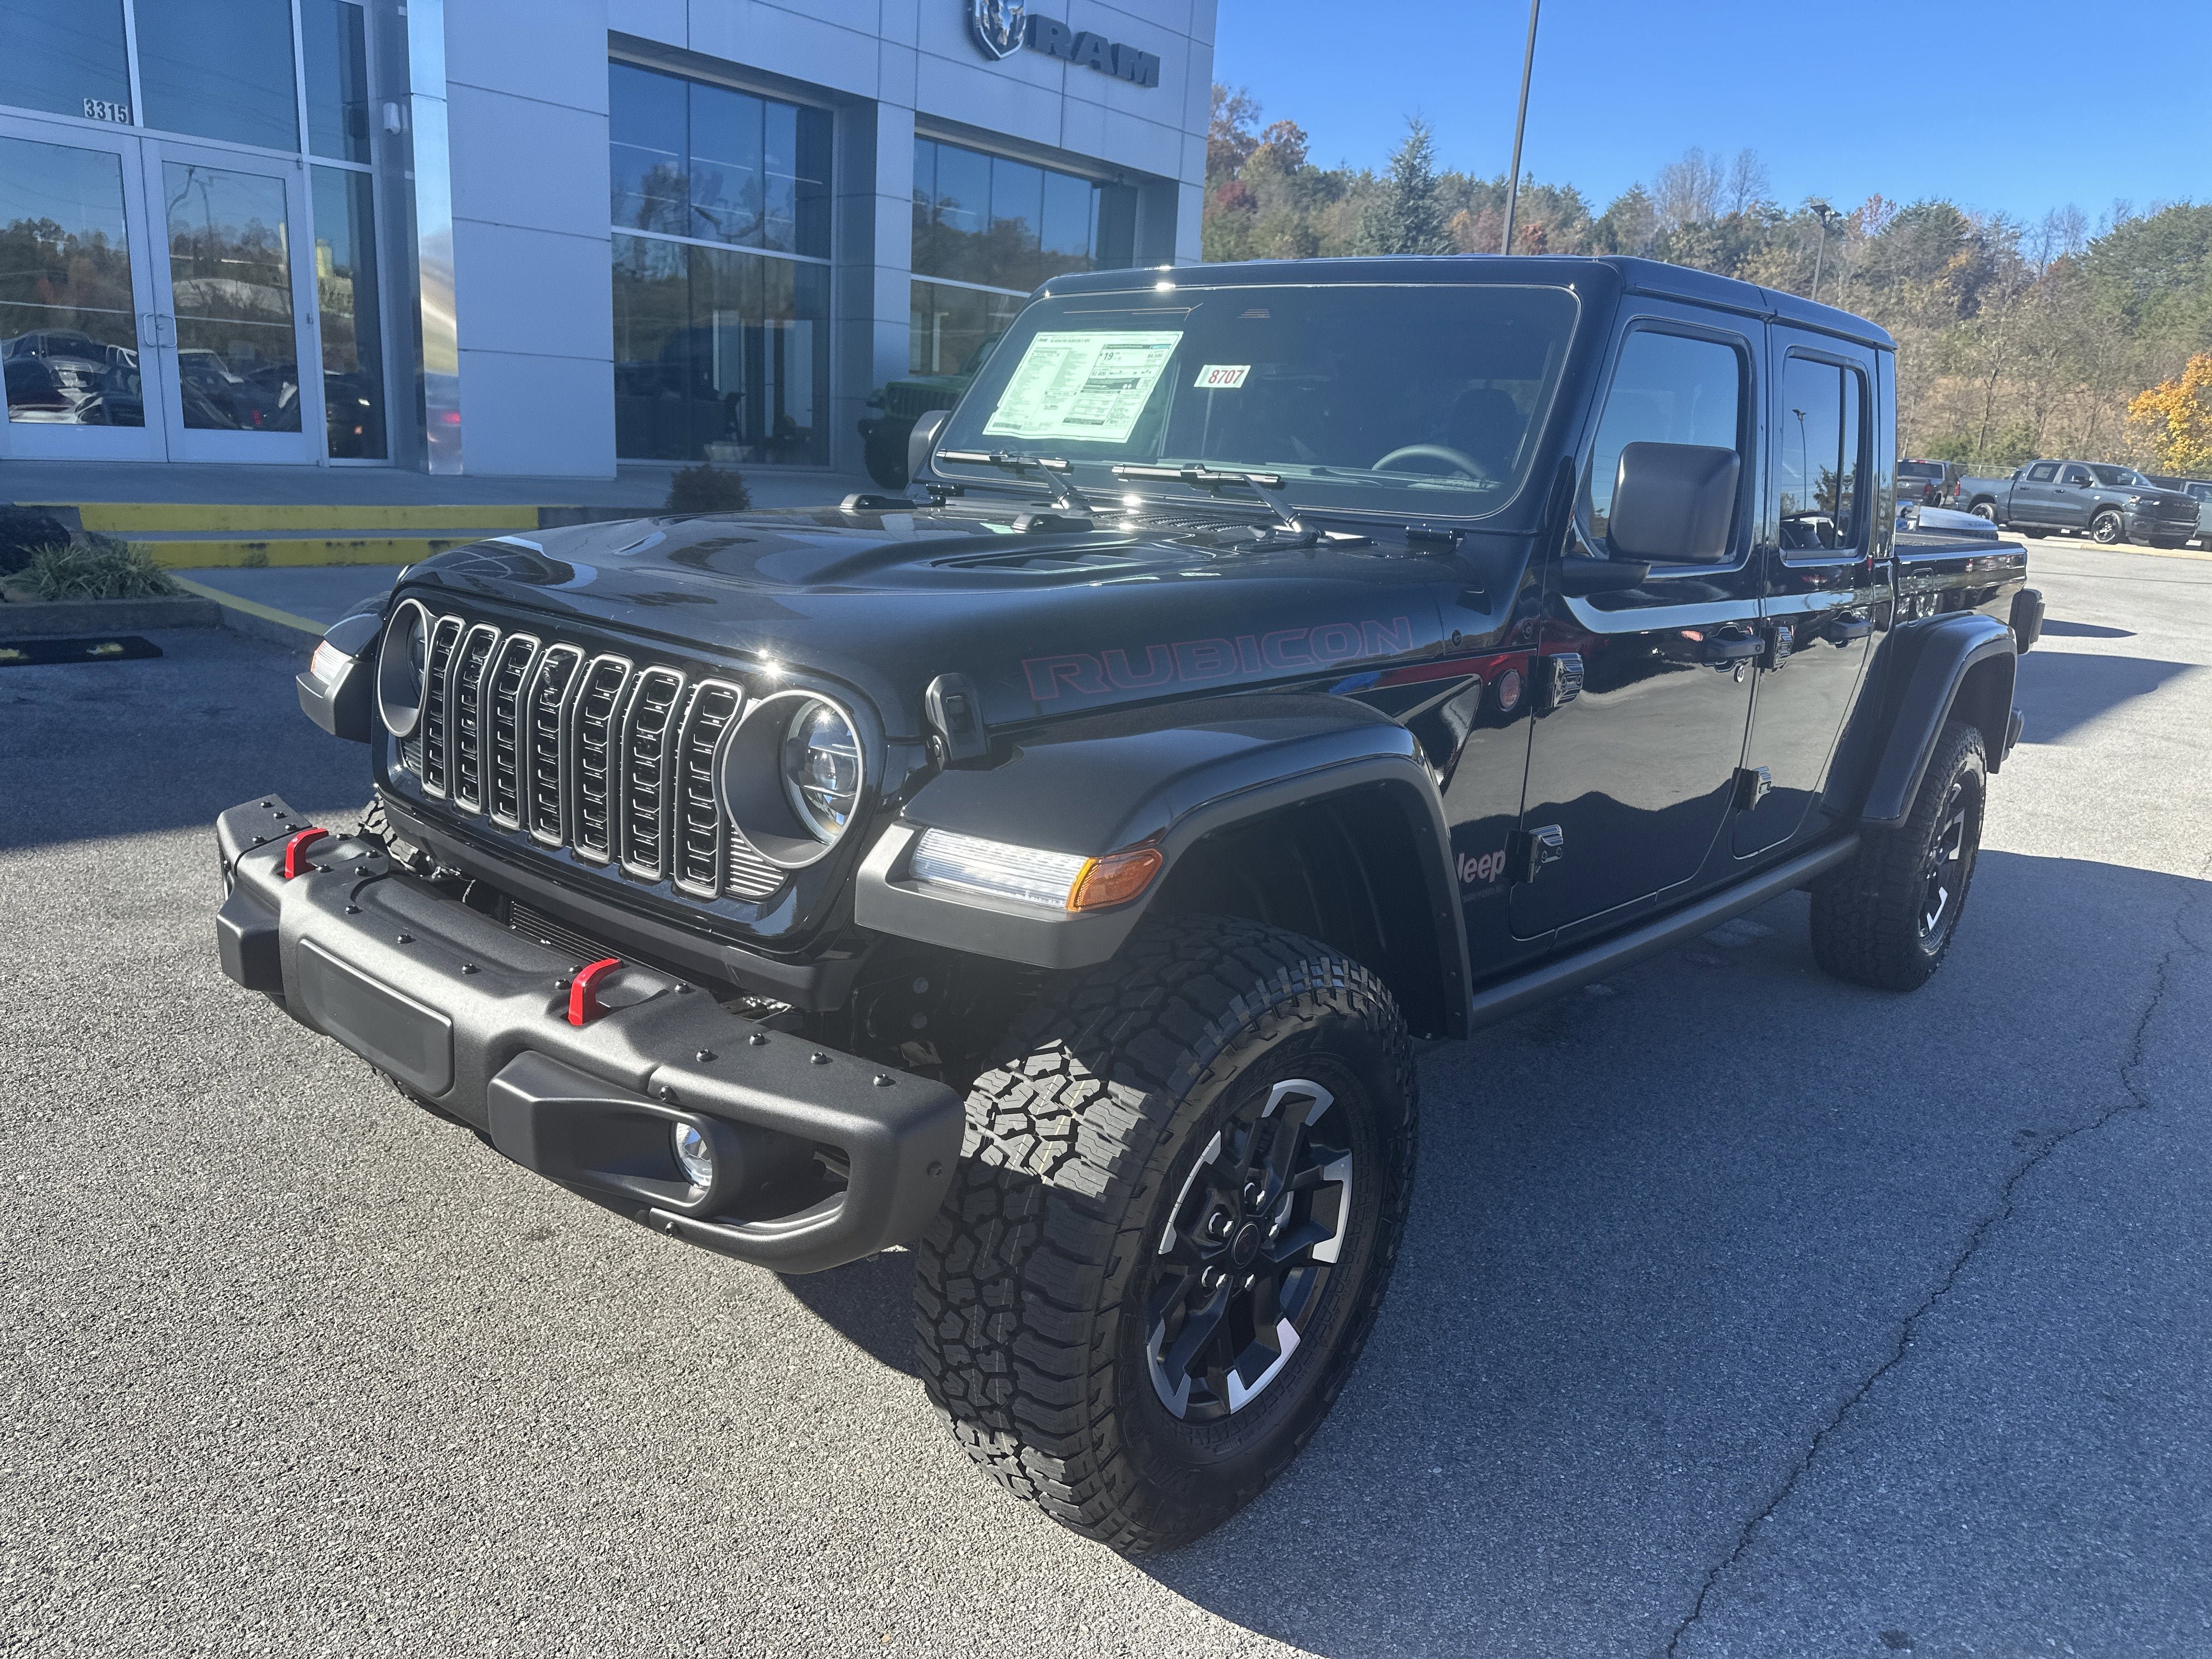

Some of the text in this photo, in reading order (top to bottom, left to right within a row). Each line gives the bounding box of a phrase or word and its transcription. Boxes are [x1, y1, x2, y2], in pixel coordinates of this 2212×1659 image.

[1026, 14, 1160, 88] RAM
[86, 99, 127, 123] 3315
[1104, 352, 1114, 360] 19
[1208, 369, 1245, 384] 8707
[1021, 616, 1414, 701] RUBICON
